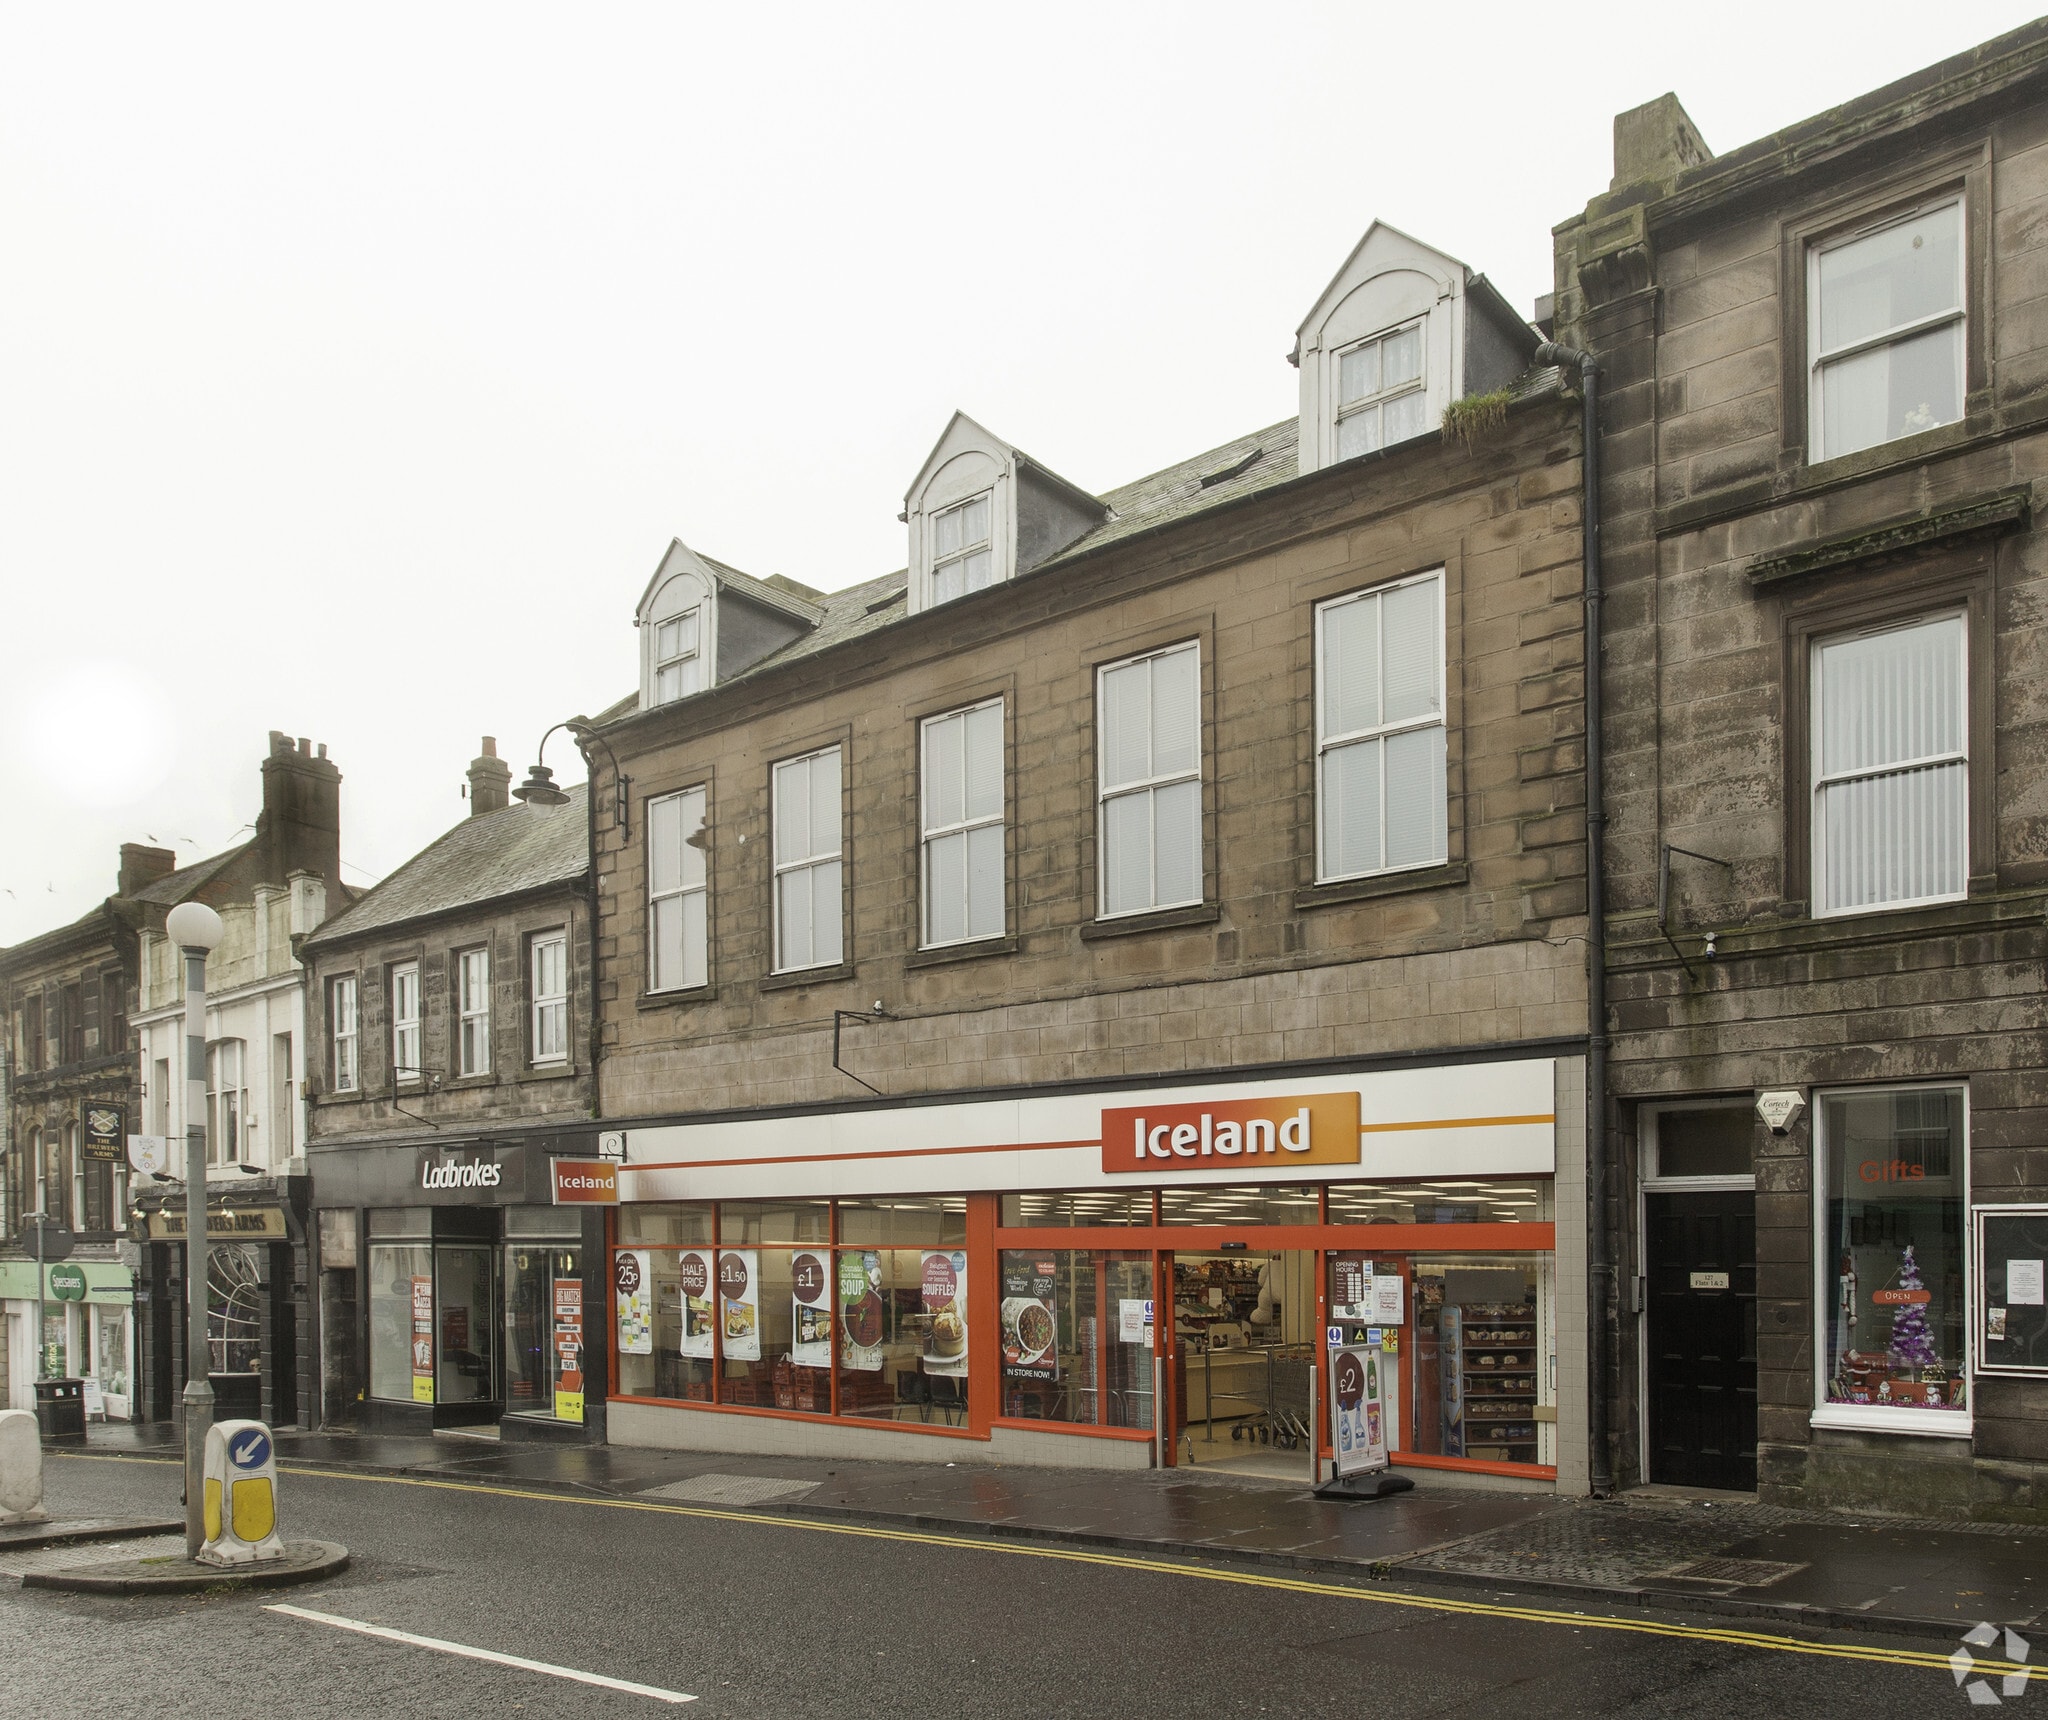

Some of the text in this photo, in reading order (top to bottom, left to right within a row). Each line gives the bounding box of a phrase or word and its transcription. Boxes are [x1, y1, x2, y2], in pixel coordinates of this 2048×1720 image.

[1134, 1107, 1311, 1158] Iceland
[422, 1158, 502, 1189] Ladbrokes
[1859, 1160, 1925, 1183] Gifts
[559, 1175, 615, 1190] Iceland
[165, 1217, 184, 1232] THE
[235, 1214, 266, 1231] ARMS
[682, 1264, 704, 1275] HALF
[720, 1265, 746, 1283] £1.50
[798, 1267, 814, 1287] £1
[52, 1275, 81, 1289] Specsavers
[683, 1277, 704, 1288] PRICE
[841, 1280, 864, 1295] SOUP
[922, 1281, 955, 1296] SOUFFLÉS
[564, 1290, 580, 1302] MATCH
[1014, 1369, 1033, 1378] STORE
[1033, 1371, 1050, 1379] NOW!
[1340, 1368, 1356, 1394] £2
